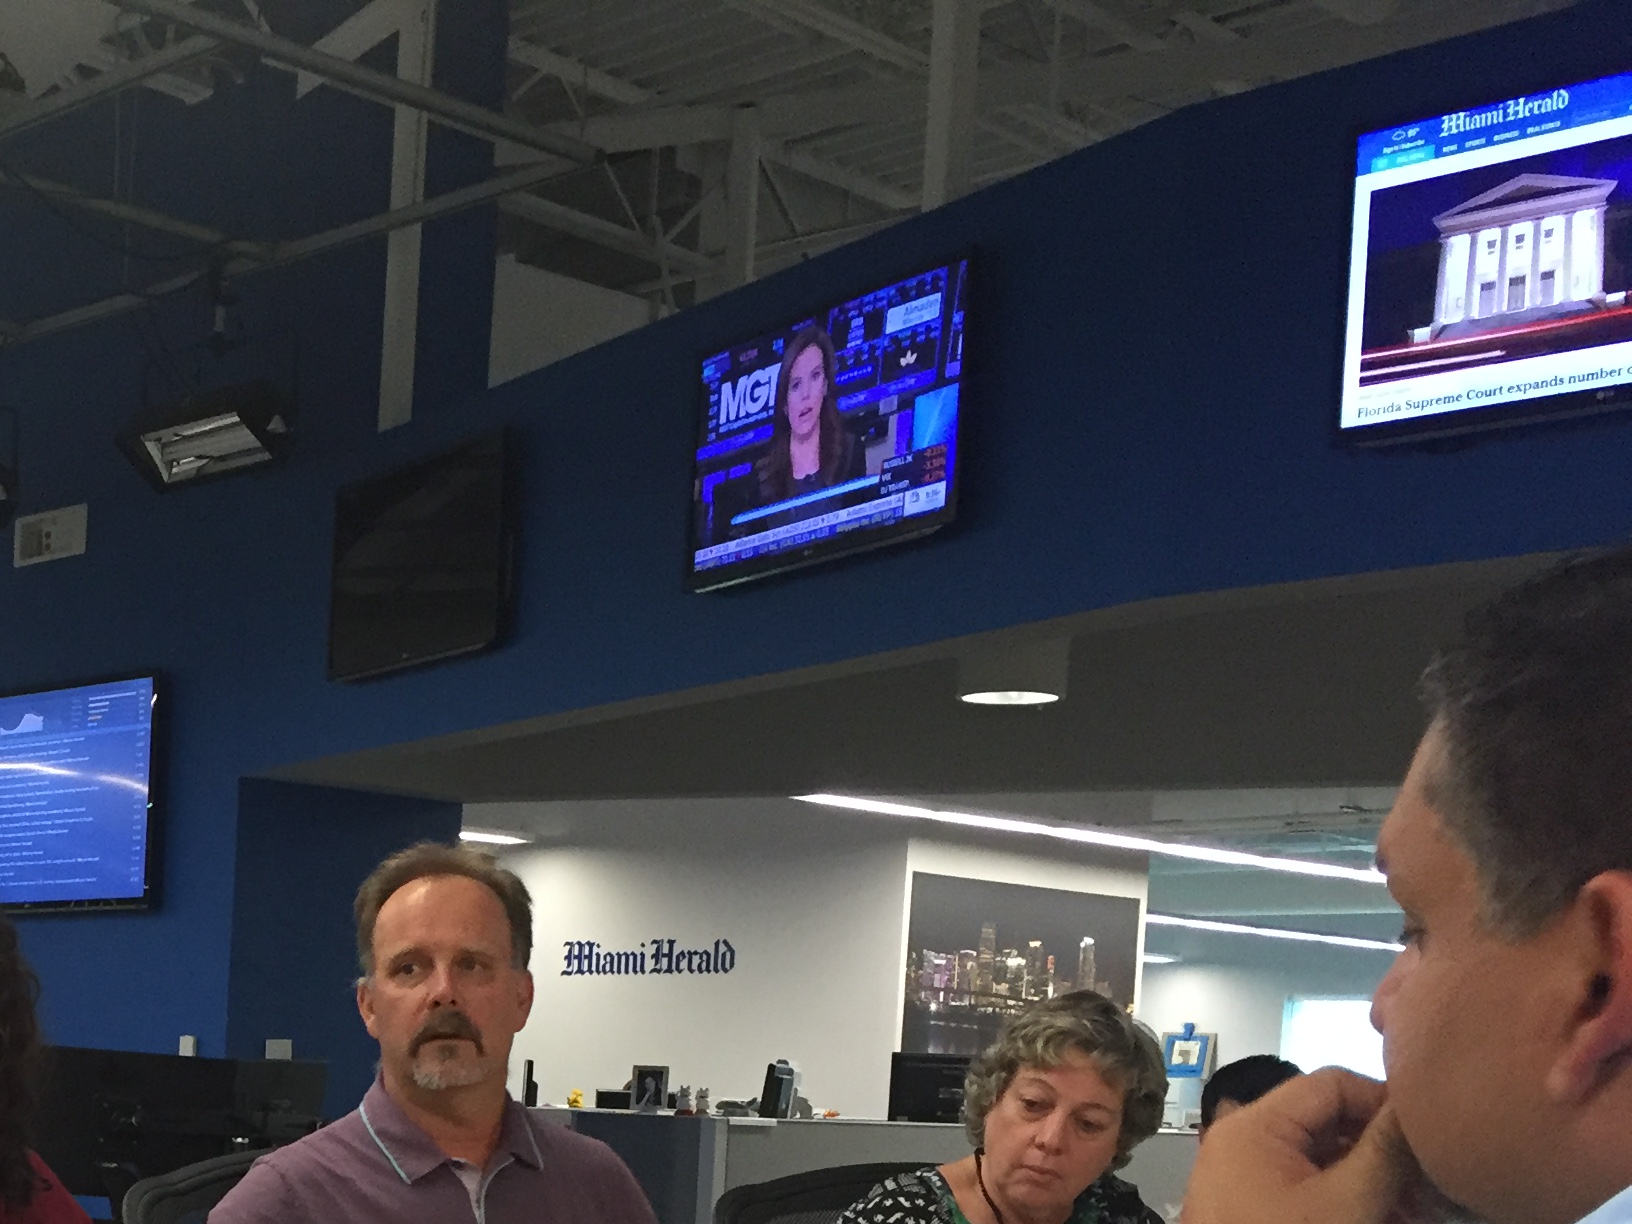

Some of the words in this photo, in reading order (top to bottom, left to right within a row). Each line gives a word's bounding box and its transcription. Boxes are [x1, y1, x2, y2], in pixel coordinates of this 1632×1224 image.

[1439, 105, 1503, 137] Miami
[1505, 89, 1569, 122] Herald
[1357, 402, 1401, 418] Florida
[1405, 393, 1463, 411] Supreme
[1466, 385, 1504, 401] Court
[1507, 376, 1564, 394] expands
[1568, 367, 1623, 385] number
[561, 940, 646, 976] Miami
[649, 938, 736, 975] Herald
